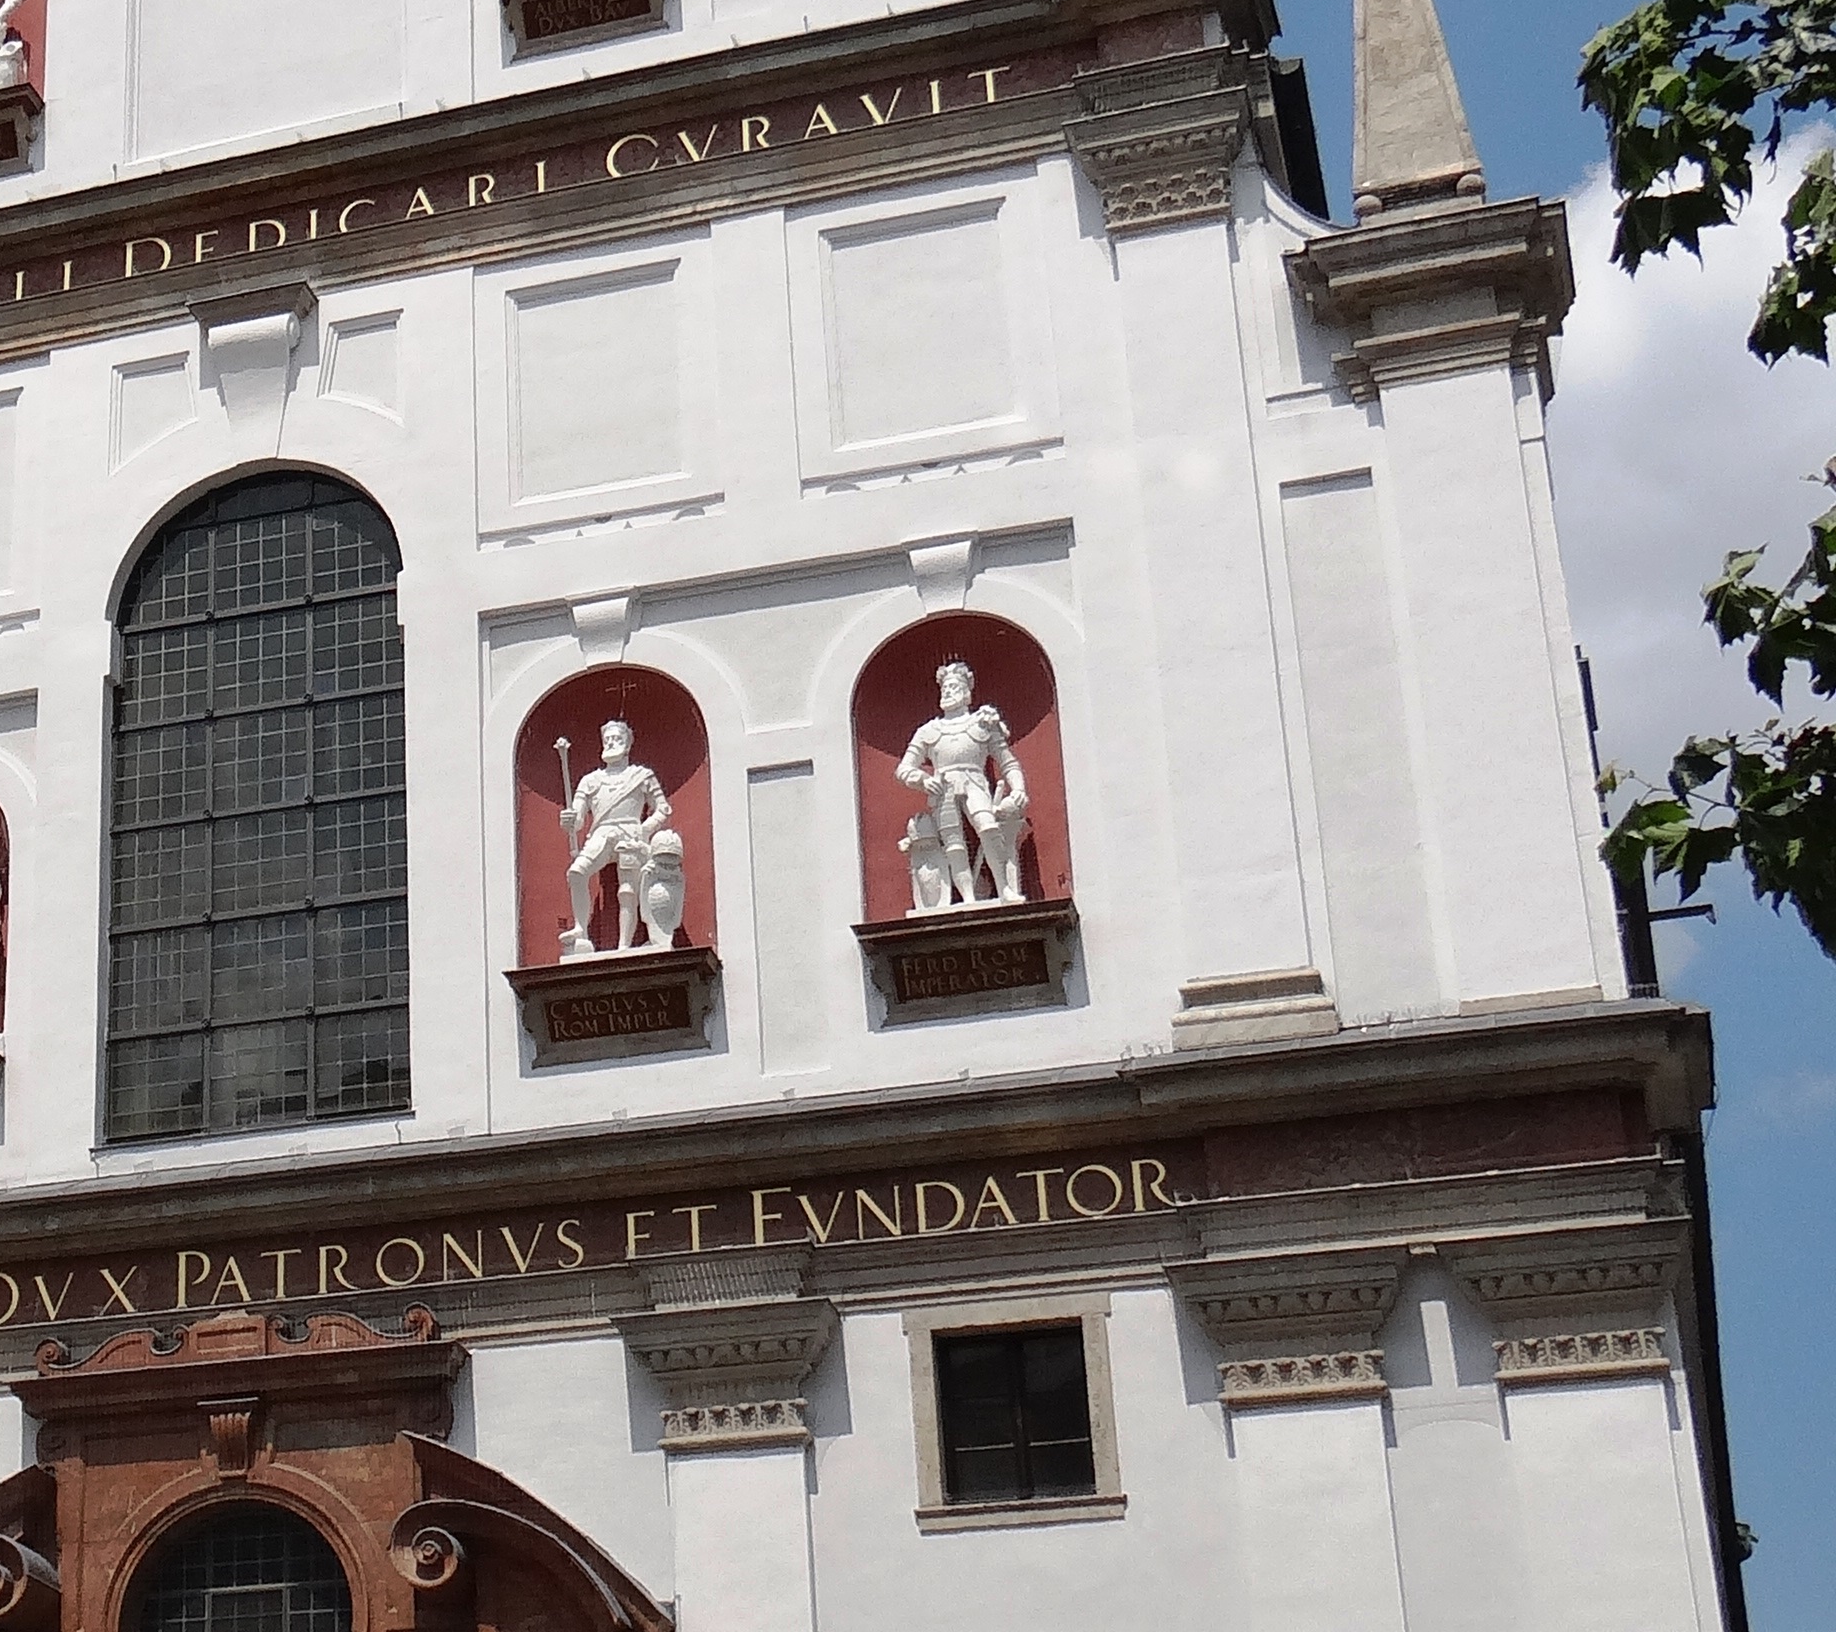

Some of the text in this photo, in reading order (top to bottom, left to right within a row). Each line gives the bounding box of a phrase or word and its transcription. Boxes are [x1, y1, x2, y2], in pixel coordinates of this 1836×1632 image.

[123, 159, 547, 278] DEDICARI
[605, 66, 1011, 178] CVRAVIT
[176, 1218, 585, 1308] PATRONVS
[624, 1204, 718, 1261] ET
[749, 1158, 1176, 1246] FVNDATOR
